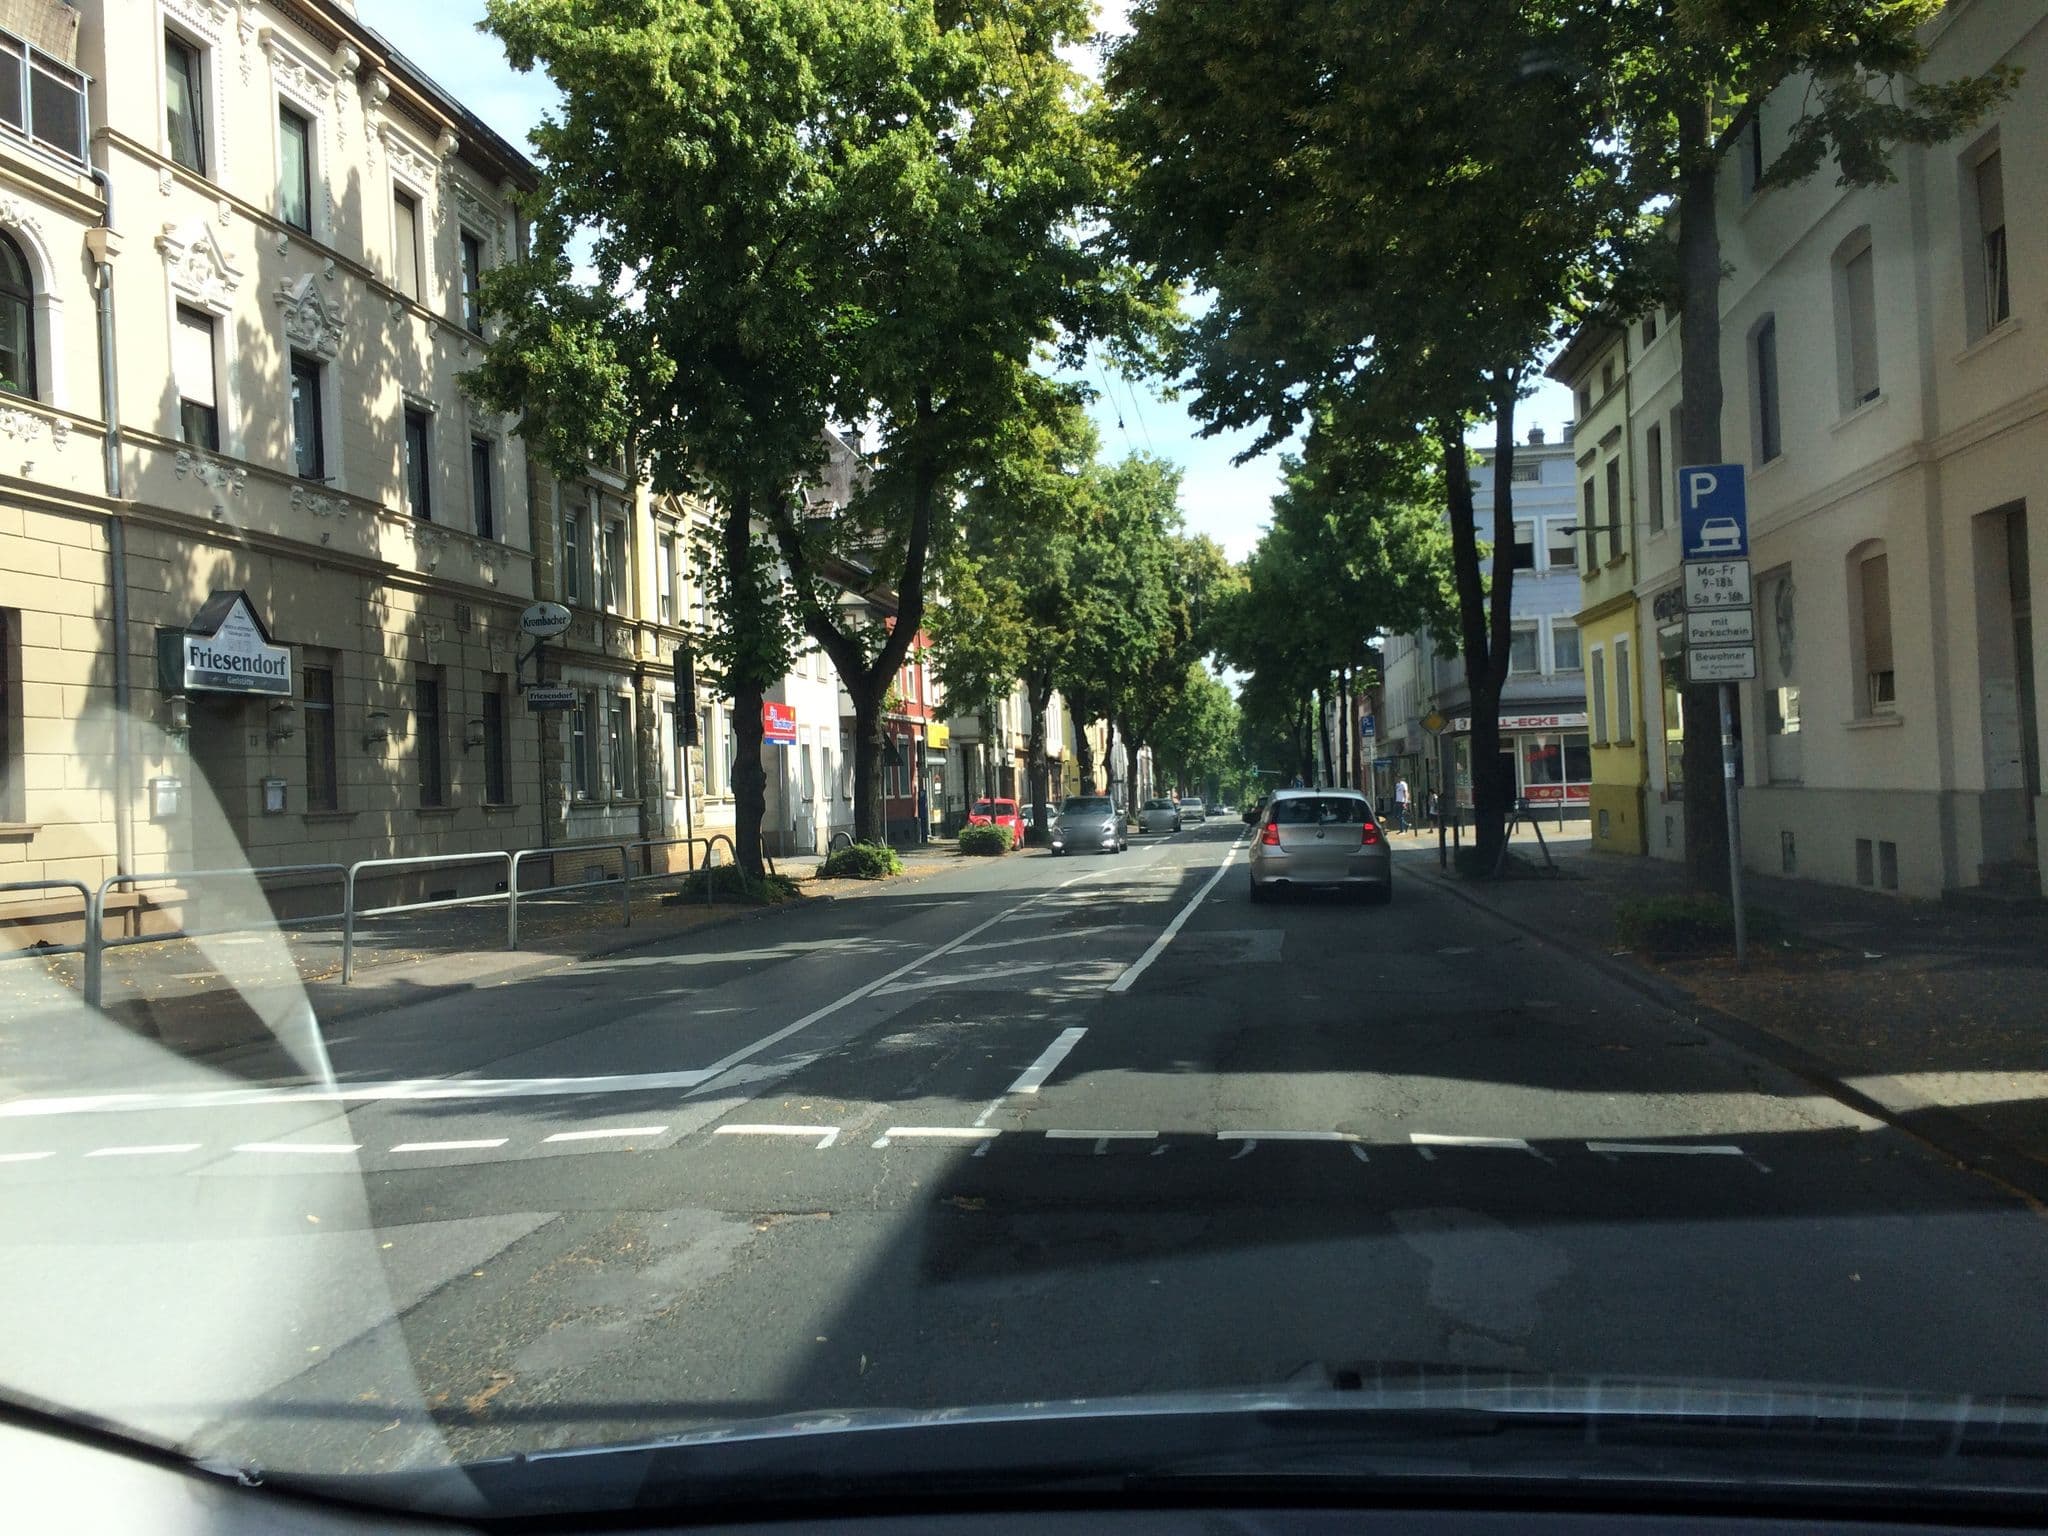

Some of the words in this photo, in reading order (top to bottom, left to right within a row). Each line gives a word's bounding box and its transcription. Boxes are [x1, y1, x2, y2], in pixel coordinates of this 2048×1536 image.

[1690, 472, 1717, 509] P
[1697, 565, 1736, 577] Mo-Fr
[1694, 592, 1709, 605] Sa
[523, 614, 567, 628] Krombacher
[1711, 617, 1728, 627] mit
[1692, 627, 1749, 638] Parkschein
[189, 645, 287, 676] Friesendorf
[1695, 651, 1746, 662] Bewohner
